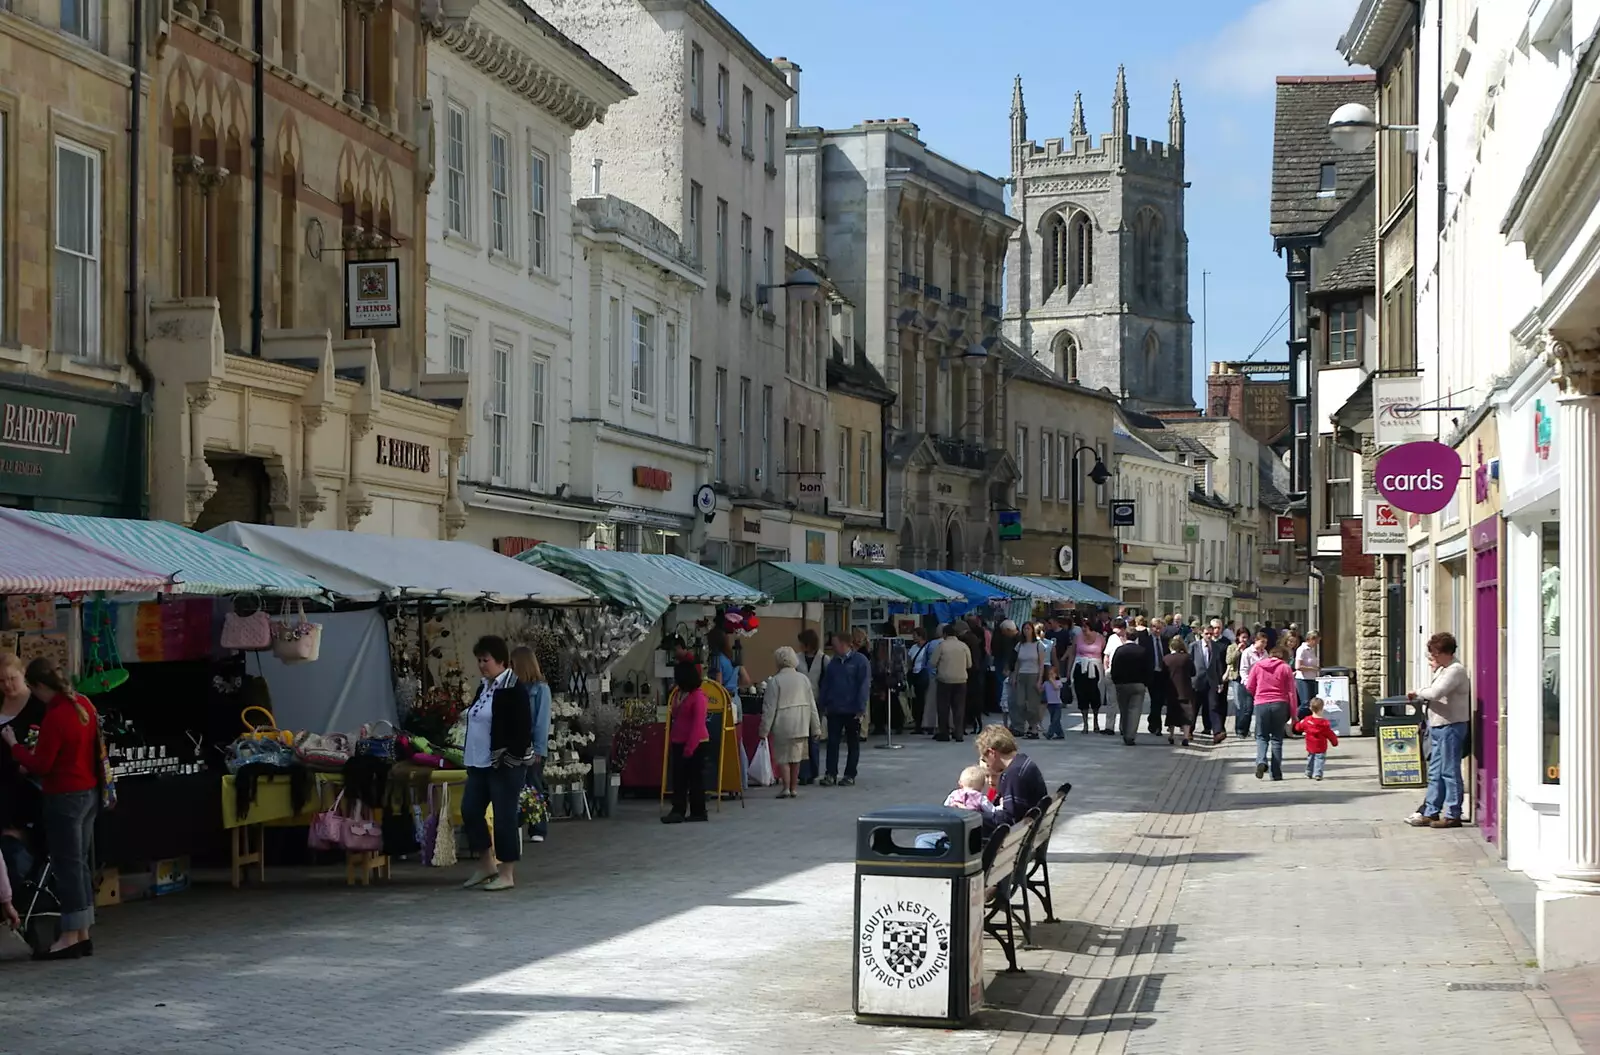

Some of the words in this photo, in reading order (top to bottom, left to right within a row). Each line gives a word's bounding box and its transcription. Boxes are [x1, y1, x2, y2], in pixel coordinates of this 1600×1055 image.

[3, 403, 77, 454] BARRETT
[800, 482, 821, 491] bon
[1383, 468, 1444, 490] cards
[1382, 729, 1396, 739] SEE
[862, 904, 893, 942] SOUTH
[897, 901, 949, 945] KESTEVEN
[862, 945, 903, 989] DISTRICT
[908, 950, 948, 989] COUNCIL
